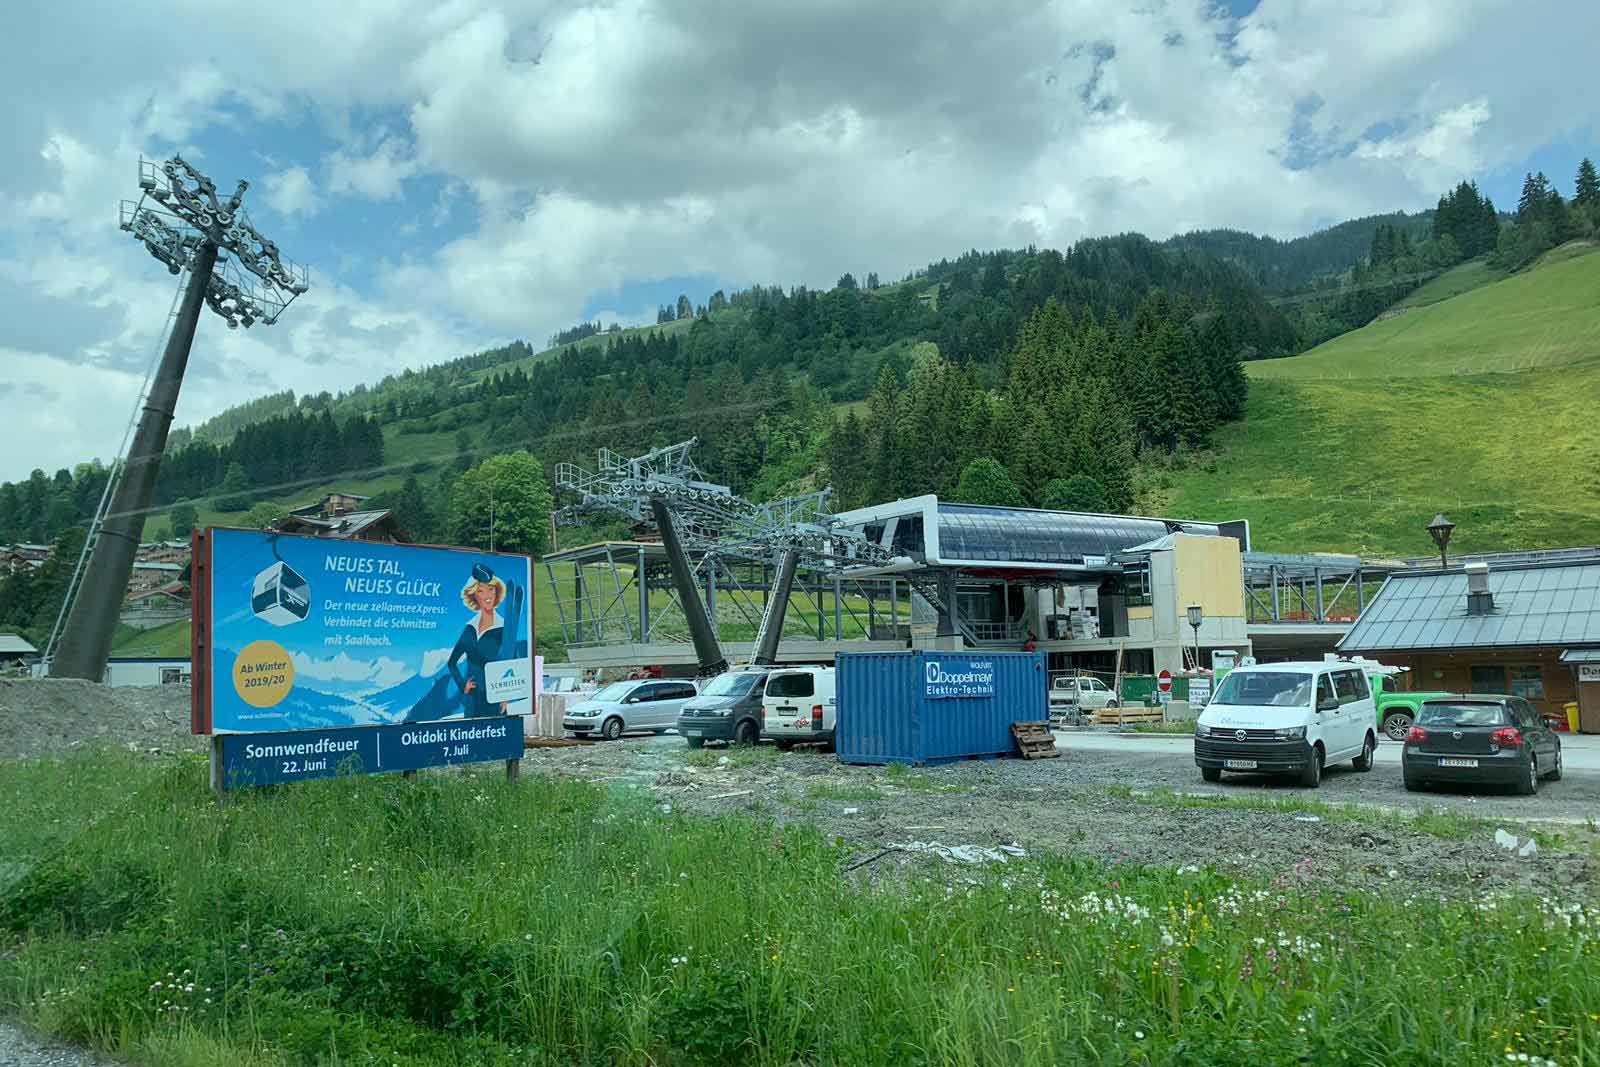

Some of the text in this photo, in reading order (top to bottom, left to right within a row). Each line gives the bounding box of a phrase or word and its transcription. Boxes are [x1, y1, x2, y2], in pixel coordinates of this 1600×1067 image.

[324, 555, 405, 577] NEUES TAL,
[344, 578, 440, 597] NEUES GLÜCK
[324, 600, 341, 611] Der
[345, 602, 368, 612] neue
[323, 616, 437, 629] Verbindet die Schmitten
[324, 634, 392, 646] mit Saalbach.
[240, 661, 287, 673] Ab Winter
[244, 675, 285, 688] 2019/20
[940, 671, 993, 684] Doppelmayr
[926, 684, 993, 695] Elektro-Technik
[401, 725, 507, 746] Okidoki Kinderfest
[246, 739, 360, 758] Sonnwendfeuer
[443, 744, 469, 757] 7. Juli
[282, 758, 327, 773] 22. Juni
